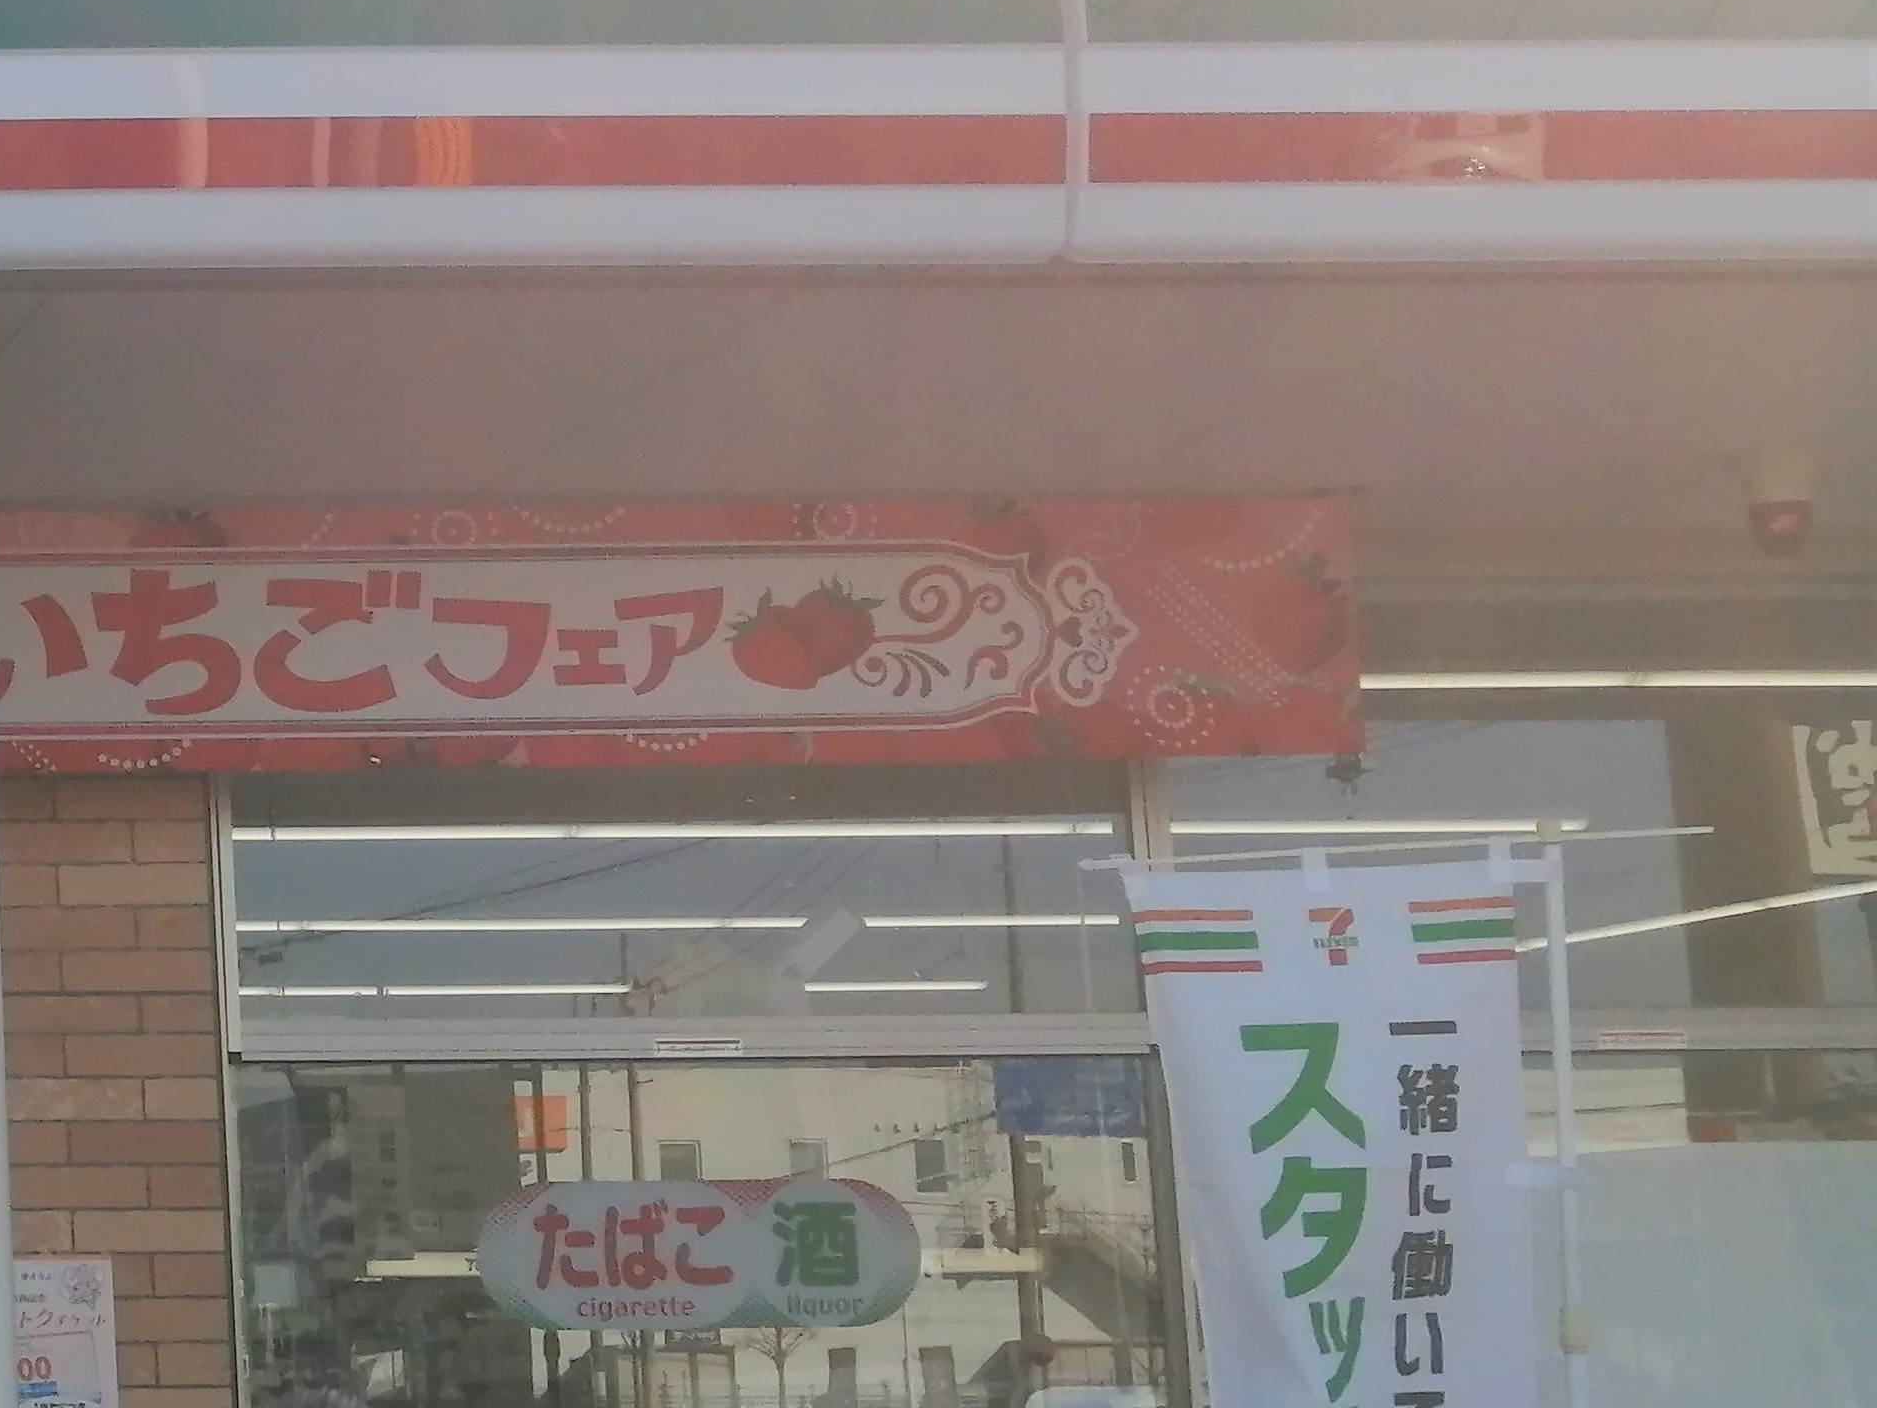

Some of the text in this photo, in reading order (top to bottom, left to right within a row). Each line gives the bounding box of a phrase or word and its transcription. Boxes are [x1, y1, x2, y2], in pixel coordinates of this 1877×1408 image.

[534, 1199, 860, 1290] たばこ 酒
[577, 1294, 864, 1322] cigarette liquor
